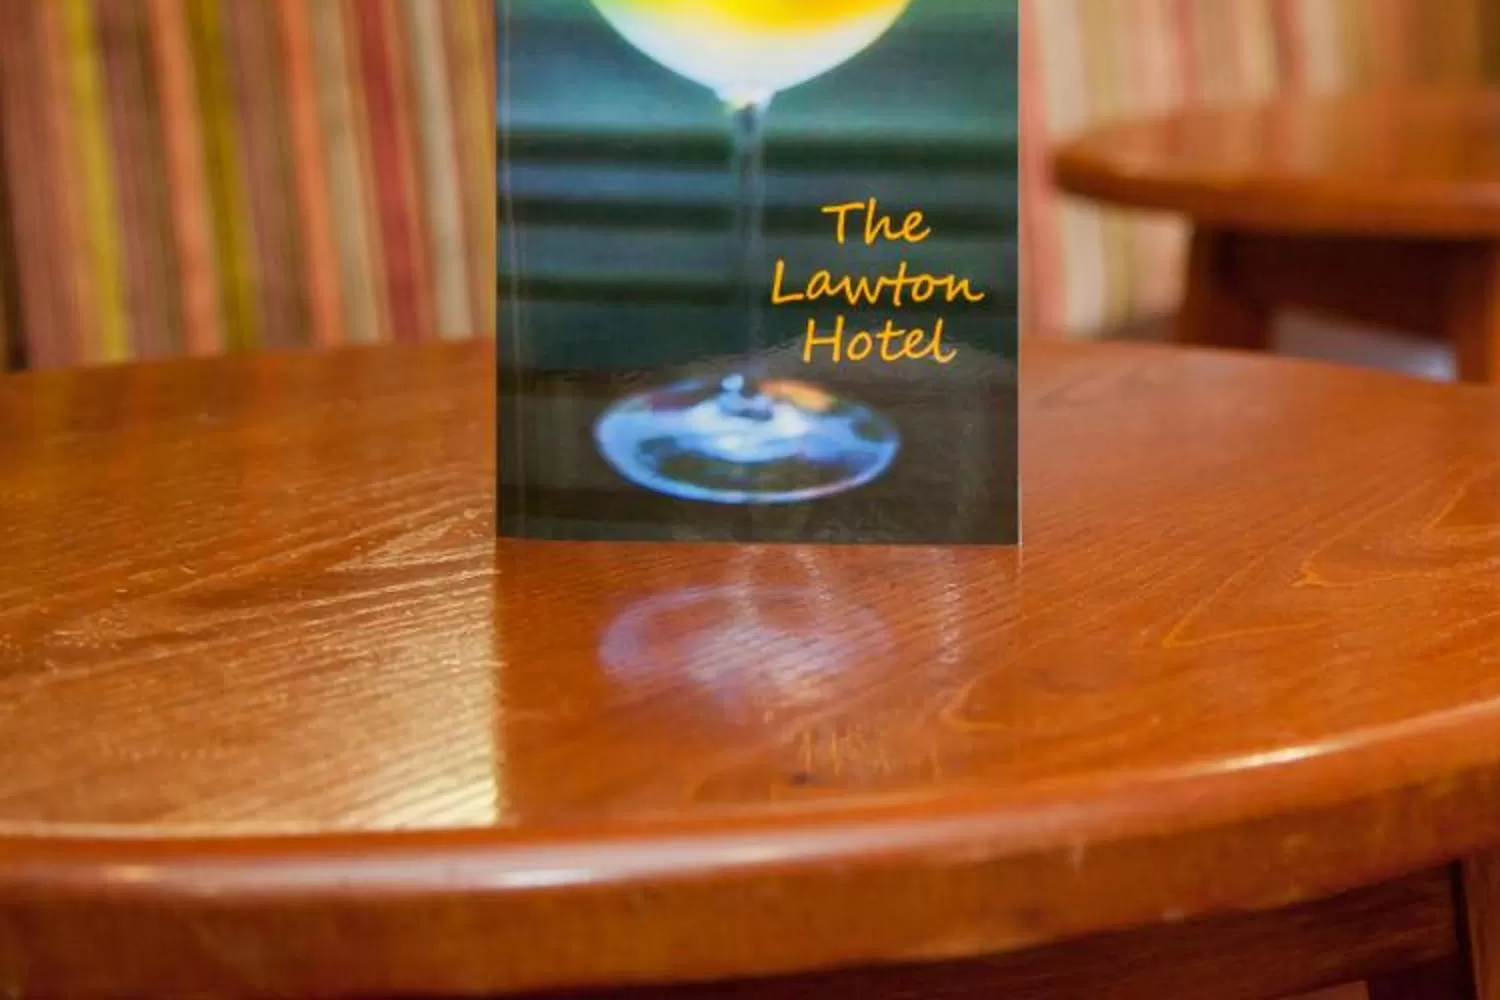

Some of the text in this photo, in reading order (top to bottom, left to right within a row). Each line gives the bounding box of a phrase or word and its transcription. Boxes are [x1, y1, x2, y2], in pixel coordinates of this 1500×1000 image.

[820, 197, 931, 246] The
[770, 259, 985, 306] Lawton
[802, 315, 957, 363] Hotel
